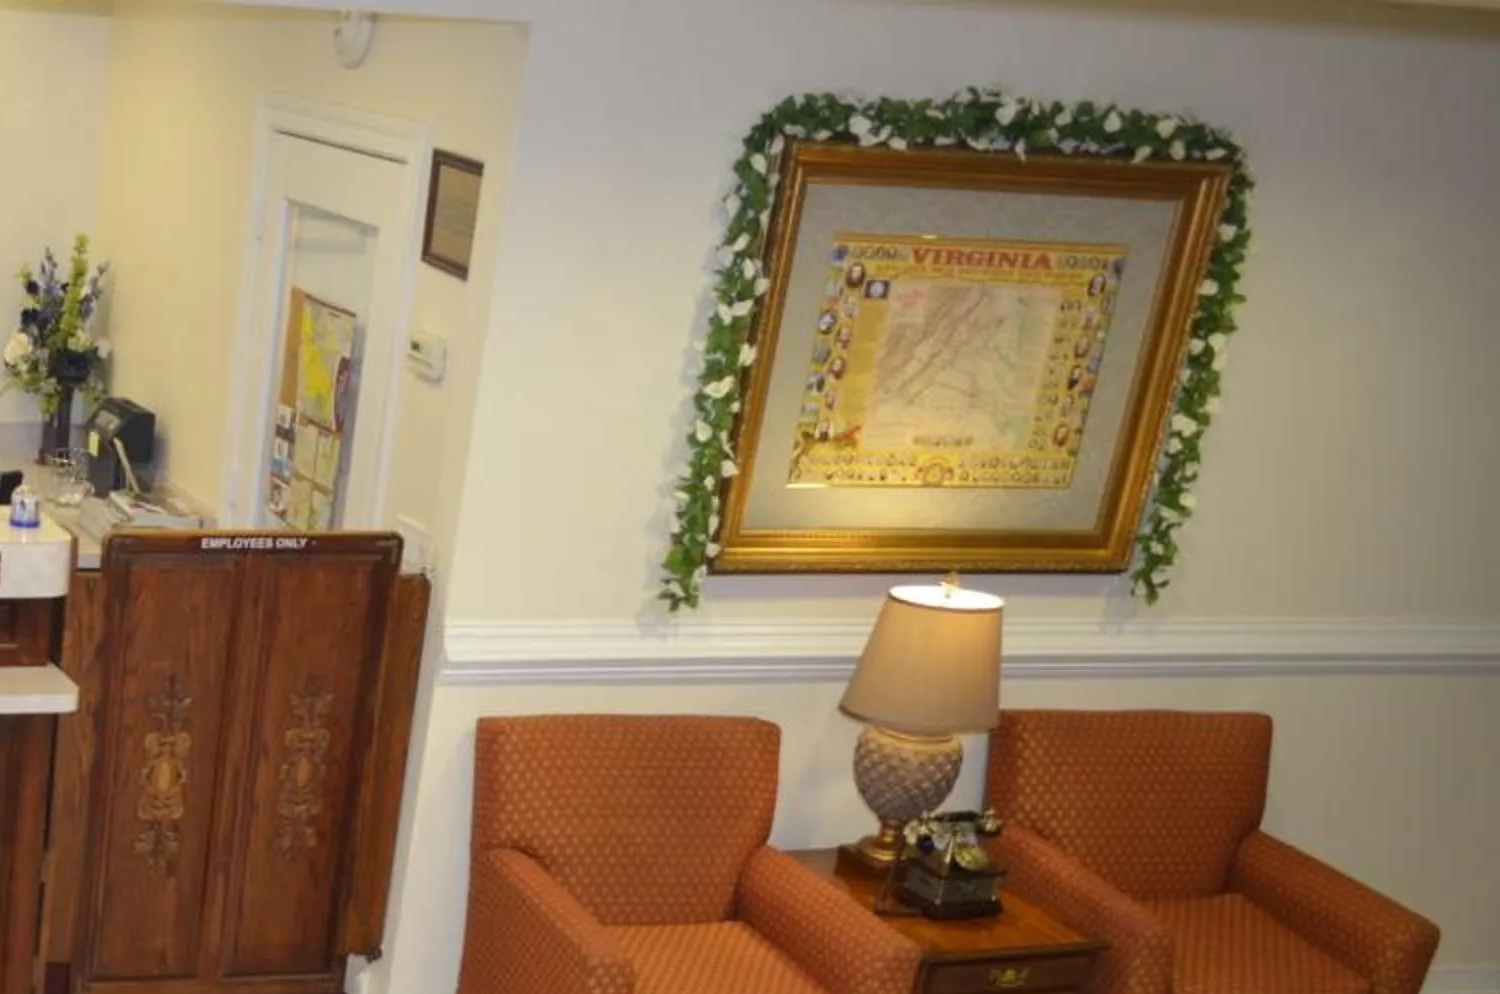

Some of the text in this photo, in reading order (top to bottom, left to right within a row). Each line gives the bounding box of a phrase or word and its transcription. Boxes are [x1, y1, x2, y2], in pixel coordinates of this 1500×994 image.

[910, 246, 1053, 270] VIRGINIA
[201, 537, 308, 549] EMPLOYEES ONLY
